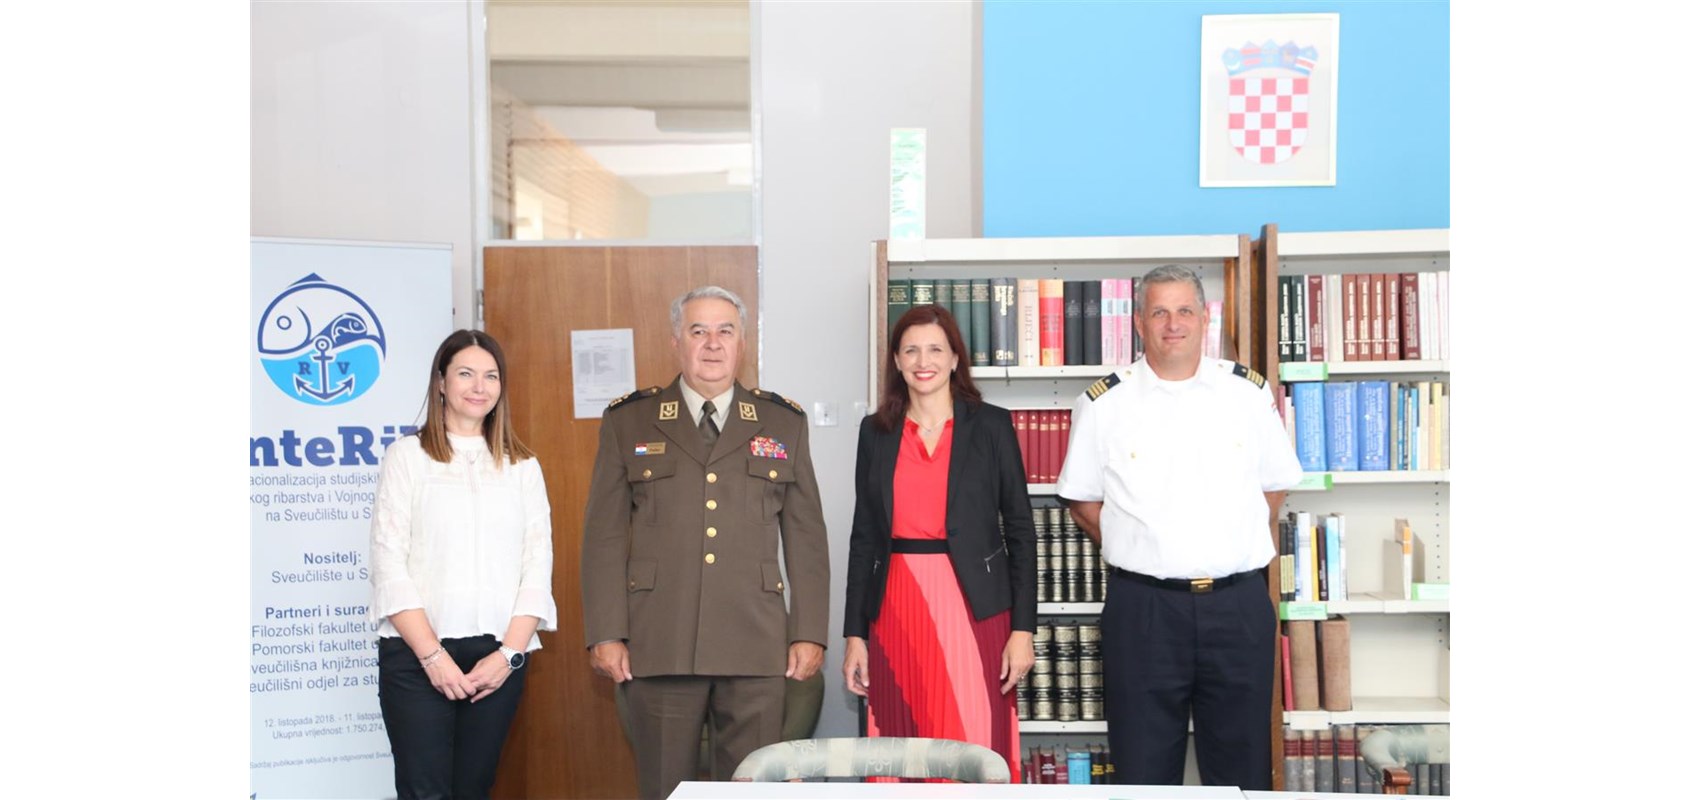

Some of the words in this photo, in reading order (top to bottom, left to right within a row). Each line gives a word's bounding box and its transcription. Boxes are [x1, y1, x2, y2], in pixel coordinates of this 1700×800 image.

[298, 362, 312, 375] R
[337, 362, 350, 375] V
[250, 425, 418, 467] nteRi
[250, 473, 326, 488] acionalizacija
[330, 472, 380, 487] studijski
[274, 491, 325, 503] ribarstva
[335, 490, 376, 505] Vojnog
[266, 511, 280, 522] na
[284, 508, 348, 521] Sveučilištu
[352, 511, 359, 519] u
[304, 551, 361, 565] Nositelj:
[271, 568, 342, 583] Sveučilište
[347, 572, 355, 580] u
[265, 605, 321, 619] Partneri
[326, 605, 330, 616] i
[252, 623, 314, 638] Filozofski
[318, 621, 366, 635] fakultet
[370, 623, 379, 632] u
[252, 641, 315, 655] Pomorski
[319, 639, 368, 652] fakultet
[322, 656, 378, 672] knjižnica
[250, 677, 302, 693] eučilišni
[307, 675, 339, 691] odjel
[343, 676, 358, 687] za
[278, 716, 313, 728] listopada
[272, 730, 303, 740] Ukupna
